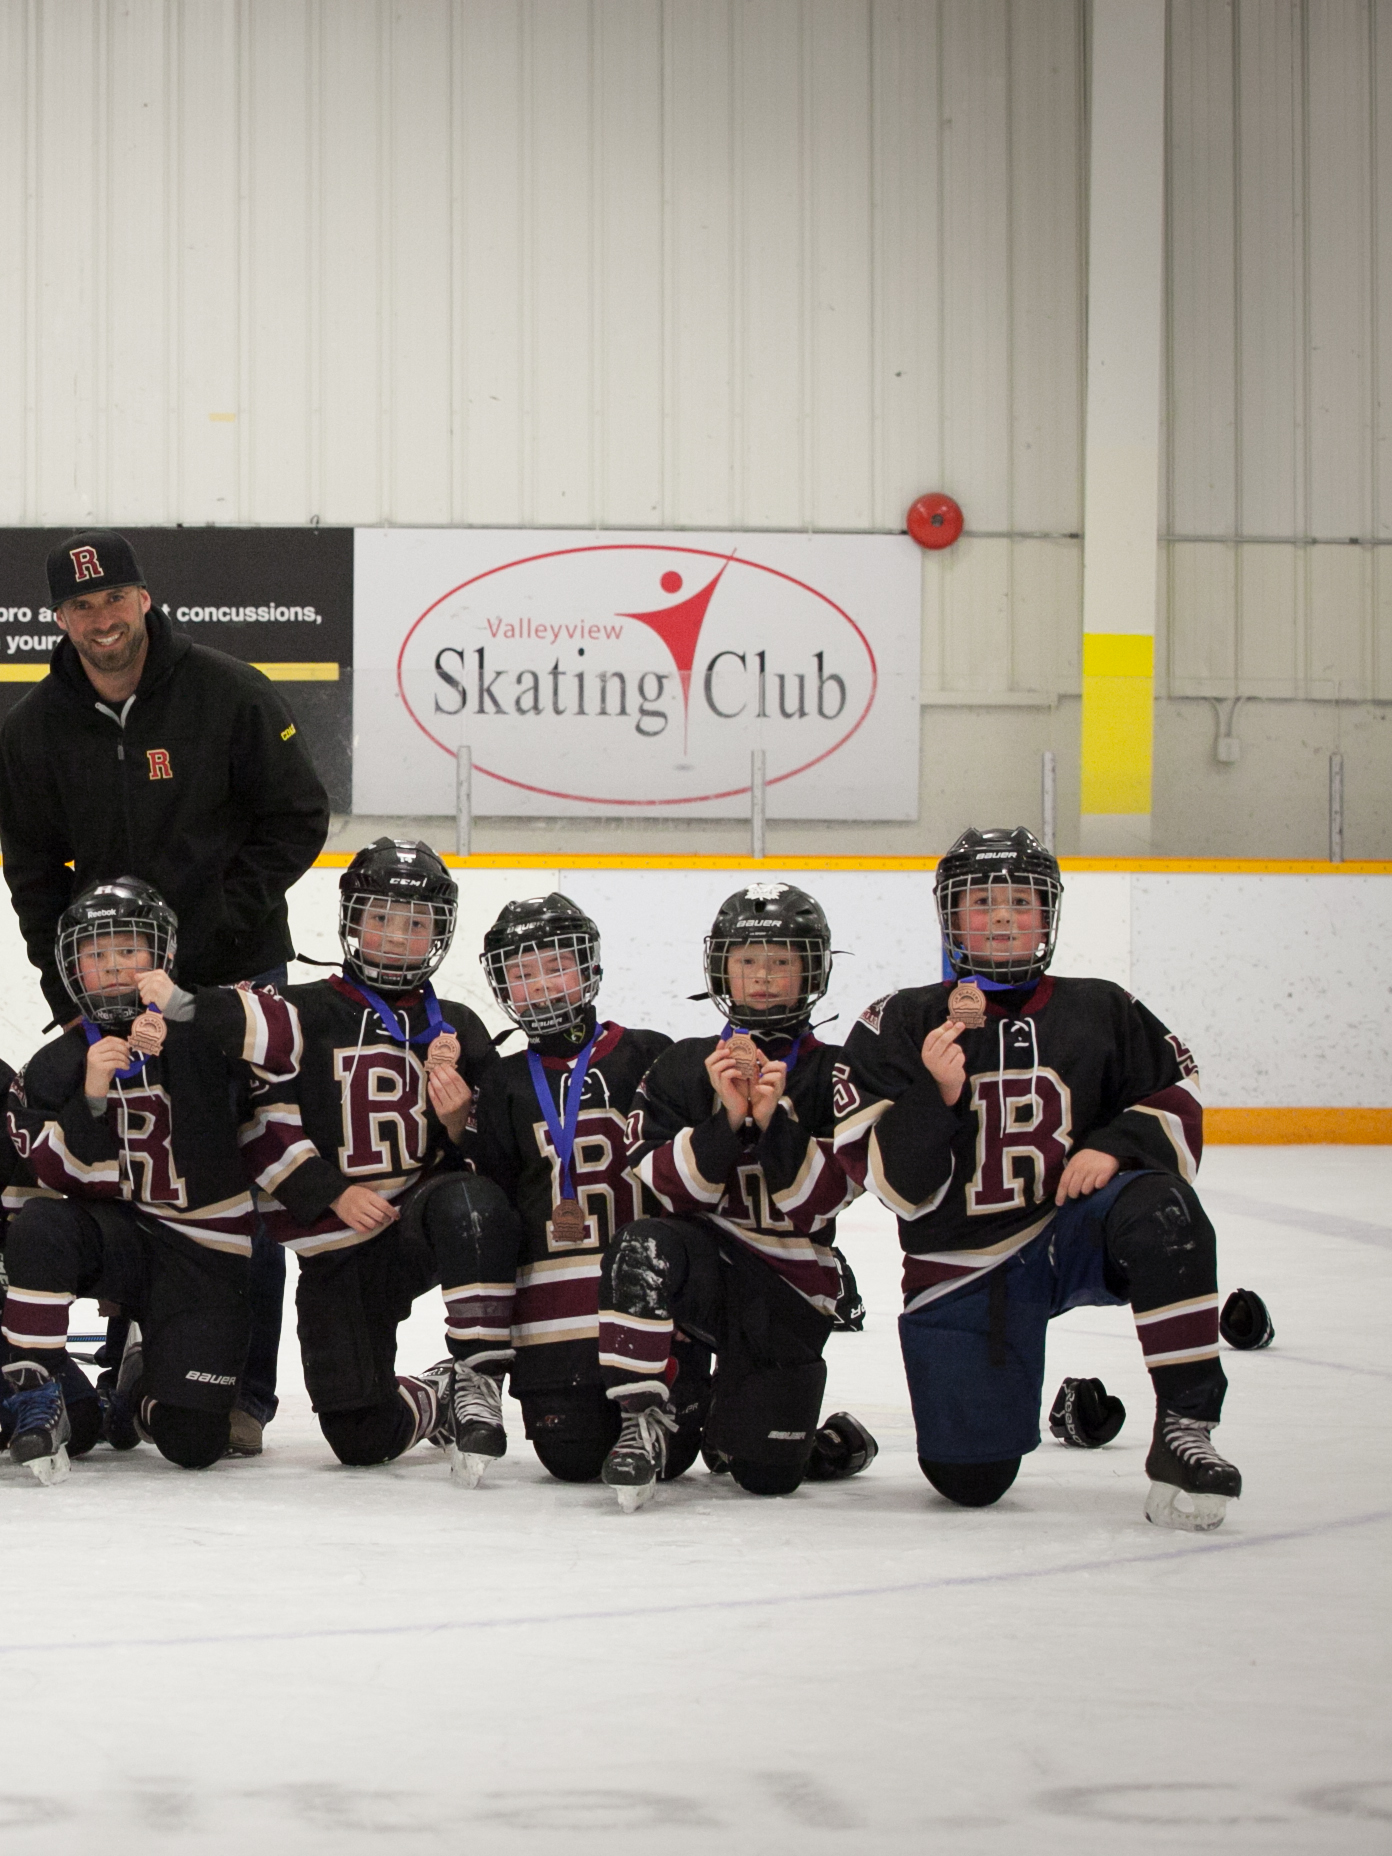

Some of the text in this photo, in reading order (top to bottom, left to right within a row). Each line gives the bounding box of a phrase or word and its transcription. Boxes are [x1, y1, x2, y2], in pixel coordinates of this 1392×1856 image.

[69, 545, 105, 582] R
[176, 602, 322, 625] concussions,
[486, 617, 624, 645] Valleyview
[433, 646, 847, 737] Skating Club
[146, 748, 174, 780] R
[87, 908, 117, 919] Reebok
[334, 1043, 430, 1178] R
[966, 1066, 1074, 1216] R
[185, 1370, 237, 1386] BAUER
